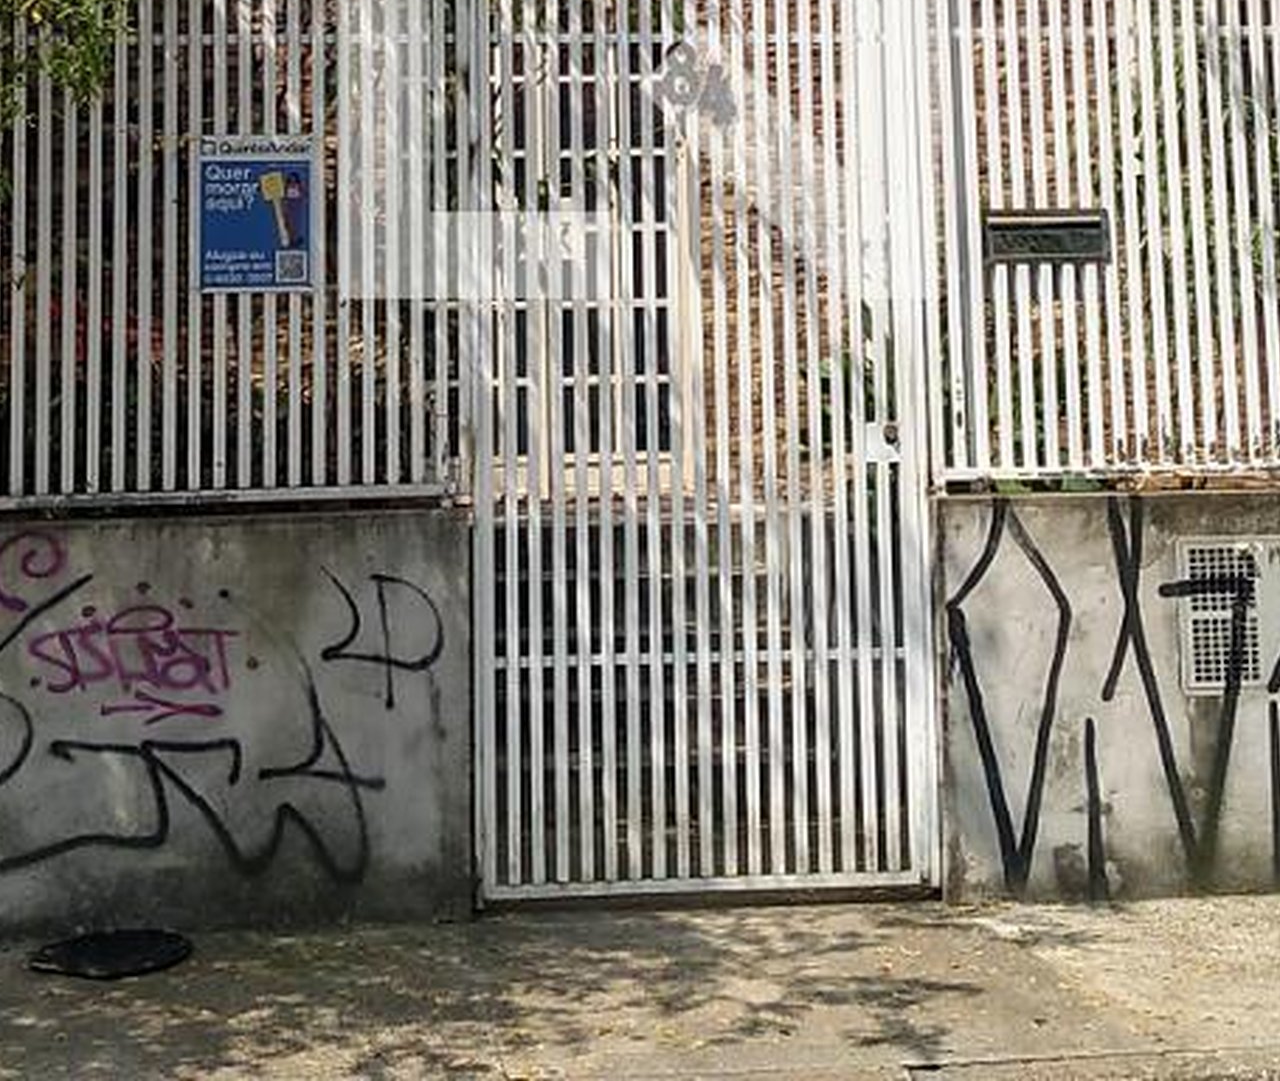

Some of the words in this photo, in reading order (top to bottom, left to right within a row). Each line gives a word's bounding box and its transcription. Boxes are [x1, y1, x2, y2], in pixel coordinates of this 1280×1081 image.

[205, 164, 251, 181] Quer
[205, 183, 259, 196] morar
[205, 196, 255, 213] aqui?
